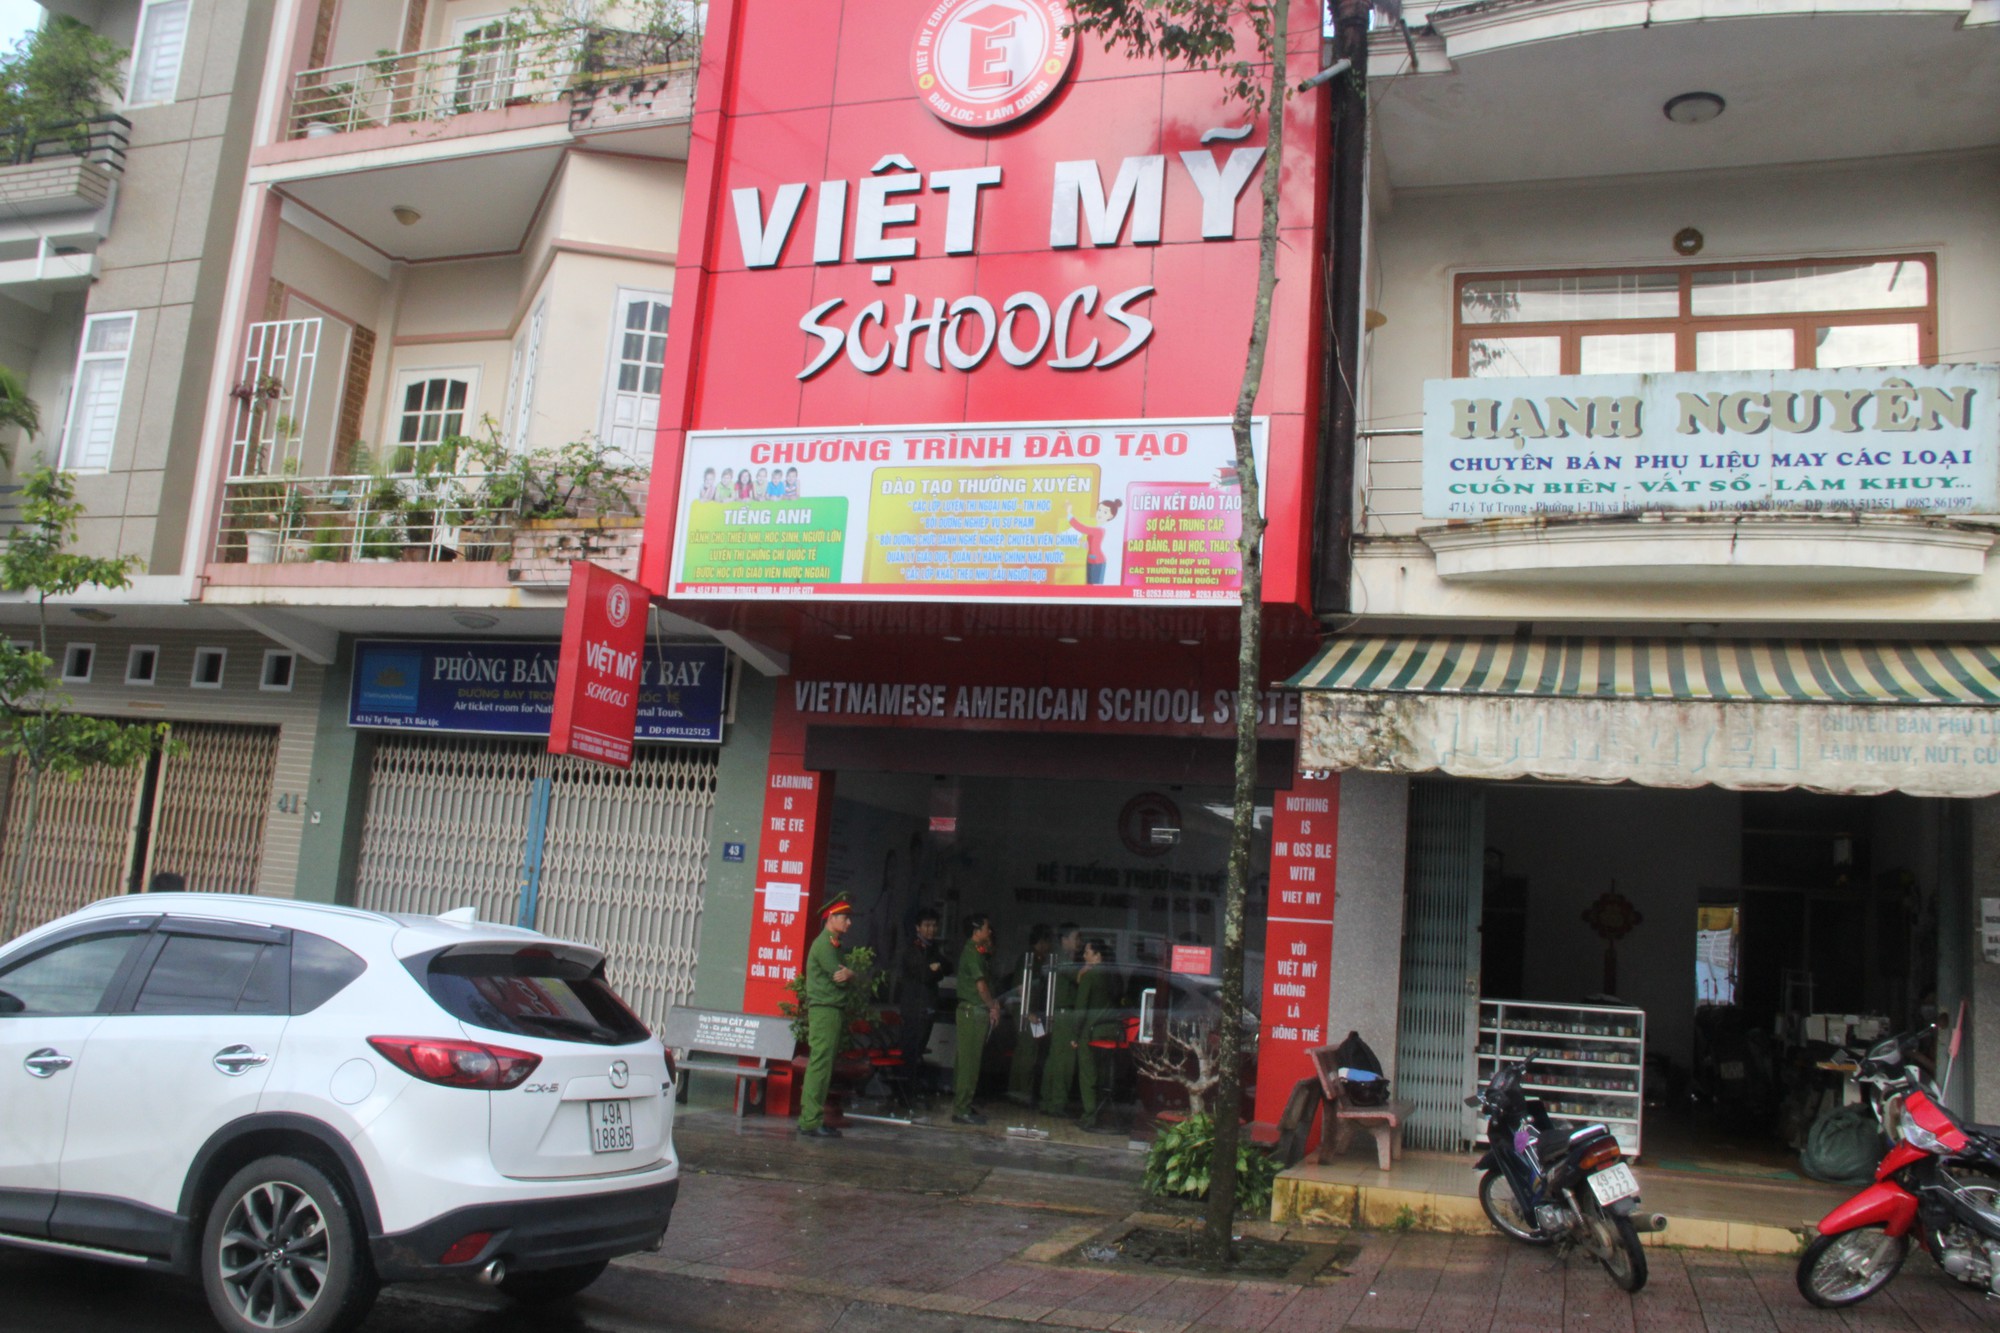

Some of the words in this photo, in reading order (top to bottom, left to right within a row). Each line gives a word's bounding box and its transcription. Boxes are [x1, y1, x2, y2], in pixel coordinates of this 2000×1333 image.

[918, 28, 933, 46] MY
[916, 50, 928, 75] VIET
[929, 92, 951, 113] BAO
[950, 107, 974, 121] LOC
[986, 104, 1014, 121] LAM
[1015, 80, 1049, 110] DONG
[732, 153, 1002, 284] VIỆT
[1050, 124, 1267, 250] MỸ
[795, 286, 1156, 380] SCHOOLS
[1449, 394, 1644, 450] HẠNH
[1675, 377, 1977, 438] NGUYÊN
[750, 439, 891, 464] CHƯƠNG
[904, 433, 1011, 460] TRÌNH
[1024, 430, 1101, 457] ĐÀO
[1114, 432, 1189, 461] TẠO
[1449, 452, 1554, 472] CHUYÊN
[1566, 448, 1622, 471] BÁN
[1634, 451, 1688, 475] PHỤ
[1699, 449, 1761, 474] LIỆU
[1771, 452, 1828, 468] MAY
[1829, 446, 1892, 467] CÁC
[1902, 450, 1973, 471] LOẠI
[881, 475, 916, 495] ĐÀO
[921, 478, 955, 498] TẠO
[958, 474, 1027, 494] THƯỜNG
[1032, 473, 1091, 493] XUYÊN
[1448, 474, 1537, 494] CUỐN
[1543, 477, 1618, 495] BIÊN
[1709, 473, 1752, 492] SỔ
[1773, 473, 1846, 492] LÀM
[1133, 492, 1160, 511] LIÊN
[1163, 490, 1187, 511] KẾT
[1189, 491, 1215, 511] ĐÀO
[1448, 502, 1460, 513] 47
[1462, 501, 1475, 516] Lý
[1495, 501, 1527, 516] Trọng
[1535, 500, 1573, 515] Phường
[1607, 502, 1619, 513] xã
[723, 505, 771, 526] TIẾNG
[776, 508, 812, 525] ANH
[1178, 518, 1205, 532] TRUNG
[586, 639, 617, 677] VIỆT
[433, 651, 507, 682] PHÒNG
[511, 653, 558, 684] BÁN
[657, 661, 705, 686] BAY
[585, 681, 630, 708] SCHOOLS
[794, 680, 946, 718] VIETNAMESE
[952, 684, 1088, 722] AMERICAN
[1097, 687, 1205, 724] SCHOOL
[453, 701, 467, 711] Air
[467, 702, 493, 712] ticket
[494, 704, 519, 713] room
[520, 703, 534, 713] for
[534, 703, 555, 714] Nati
[636, 707, 655, 717] onal
[656, 707, 683, 718] Tours
[771, 774, 813, 790] LEARNING
[278, 793, 299, 814] 41
[784, 796, 793, 811] IS
[1286, 796, 1329, 813] NOTHING
[771, 817, 786, 831] THE
[788, 818, 804, 832] EYE
[1300, 819, 1311, 835] IS
[728, 845, 740, 856] 43
[779, 840, 790, 853] OF
[764, 859, 779, 873] THE
[781, 860, 803, 875] MIND
[1290, 866, 1315, 882] WITH
[1281, 890, 1302, 904] VIET
[1305, 891, 1322, 905] MY
[763, 911, 778, 926] HỌC
[780, 910, 795, 926] TẬP
[771, 927, 781, 943] LÀ
[758, 946, 774, 960] CON
[775, 946, 793, 962] MẮT
[1291, 940, 1307, 957] VỚI
[751, 960, 766, 977] CỦA
[768, 962, 780, 979] TRÍ
[781, 963, 797, 982] TUỆ
[1277, 959, 1298, 978] VIỆT
[1302, 959, 1318, 978] MỸ
[1273, 982, 1306, 998] KHÔNG
[1288, 1002, 1301, 1018] LÀ
[744, 1019, 760, 1029] ANH
[1302, 1024, 1320, 1042] THỂ
[523, 1083, 560, 1093] CX-5
[601, 1103, 622, 1125] 49A
[595, 1125, 632, 1149] 188.85
[1600, 1180, 1633, 1203] 3222
